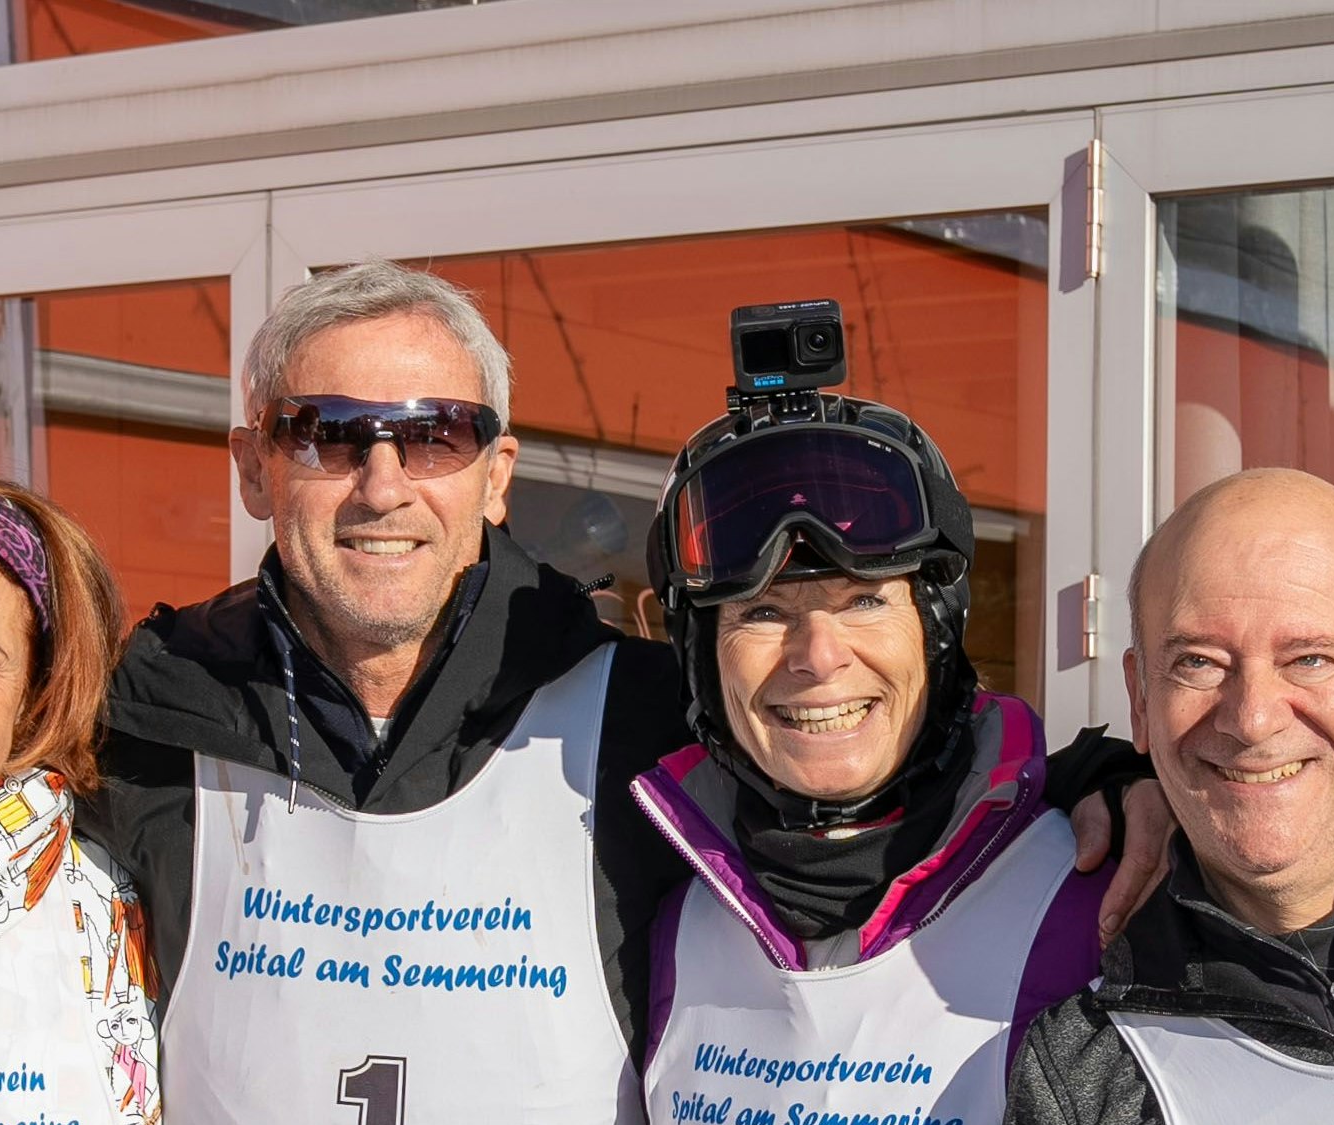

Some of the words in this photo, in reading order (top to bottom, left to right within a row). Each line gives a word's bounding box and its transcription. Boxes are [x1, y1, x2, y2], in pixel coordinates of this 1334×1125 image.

[244, 886, 532, 938] Wintersportverein
[215, 939, 305, 981] Spital
[315, 958, 370, 988] am
[382, 953, 568, 999] Semmering
[694, 1042, 932, 1089] Wintersportverein
